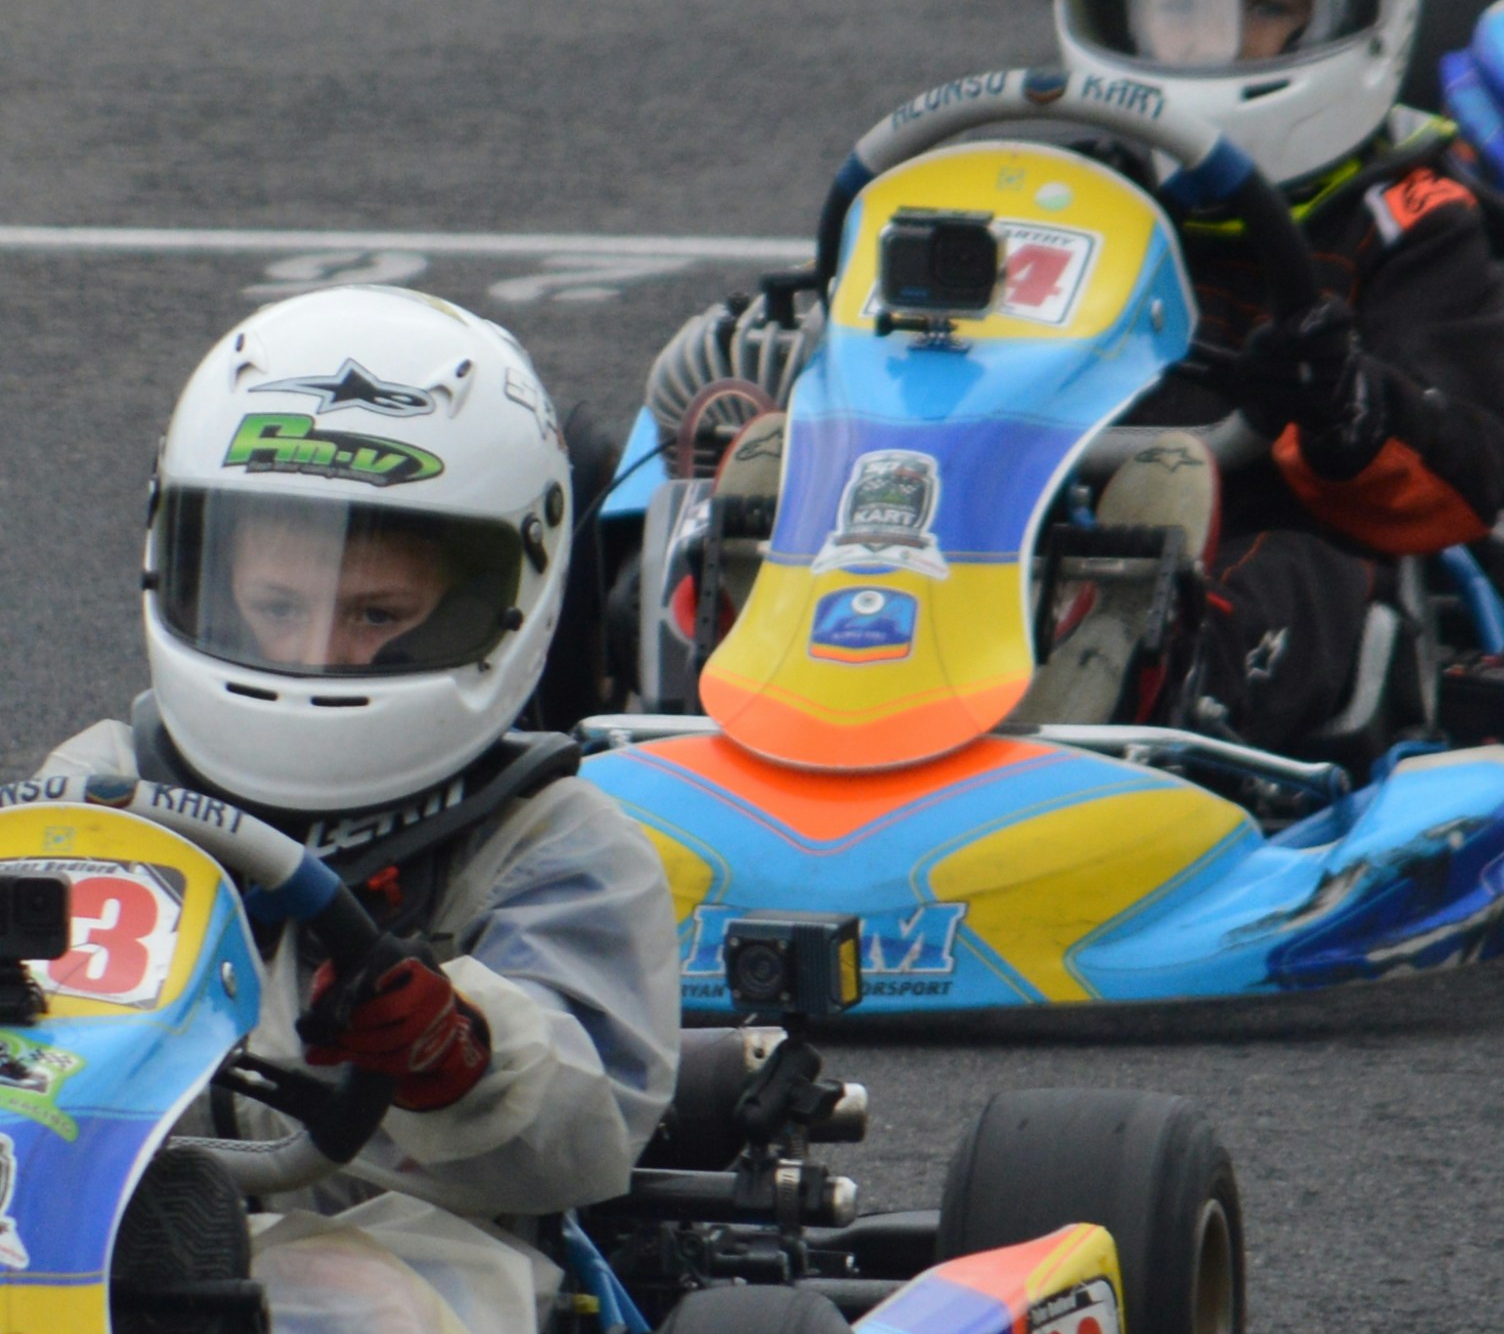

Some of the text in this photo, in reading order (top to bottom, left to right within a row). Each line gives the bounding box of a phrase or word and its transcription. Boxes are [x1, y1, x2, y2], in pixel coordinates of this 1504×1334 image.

[891, 71, 1168, 131] ALONSO KART
[1005, 243, 1073, 308] 4
[151, 782, 245, 834] KART
